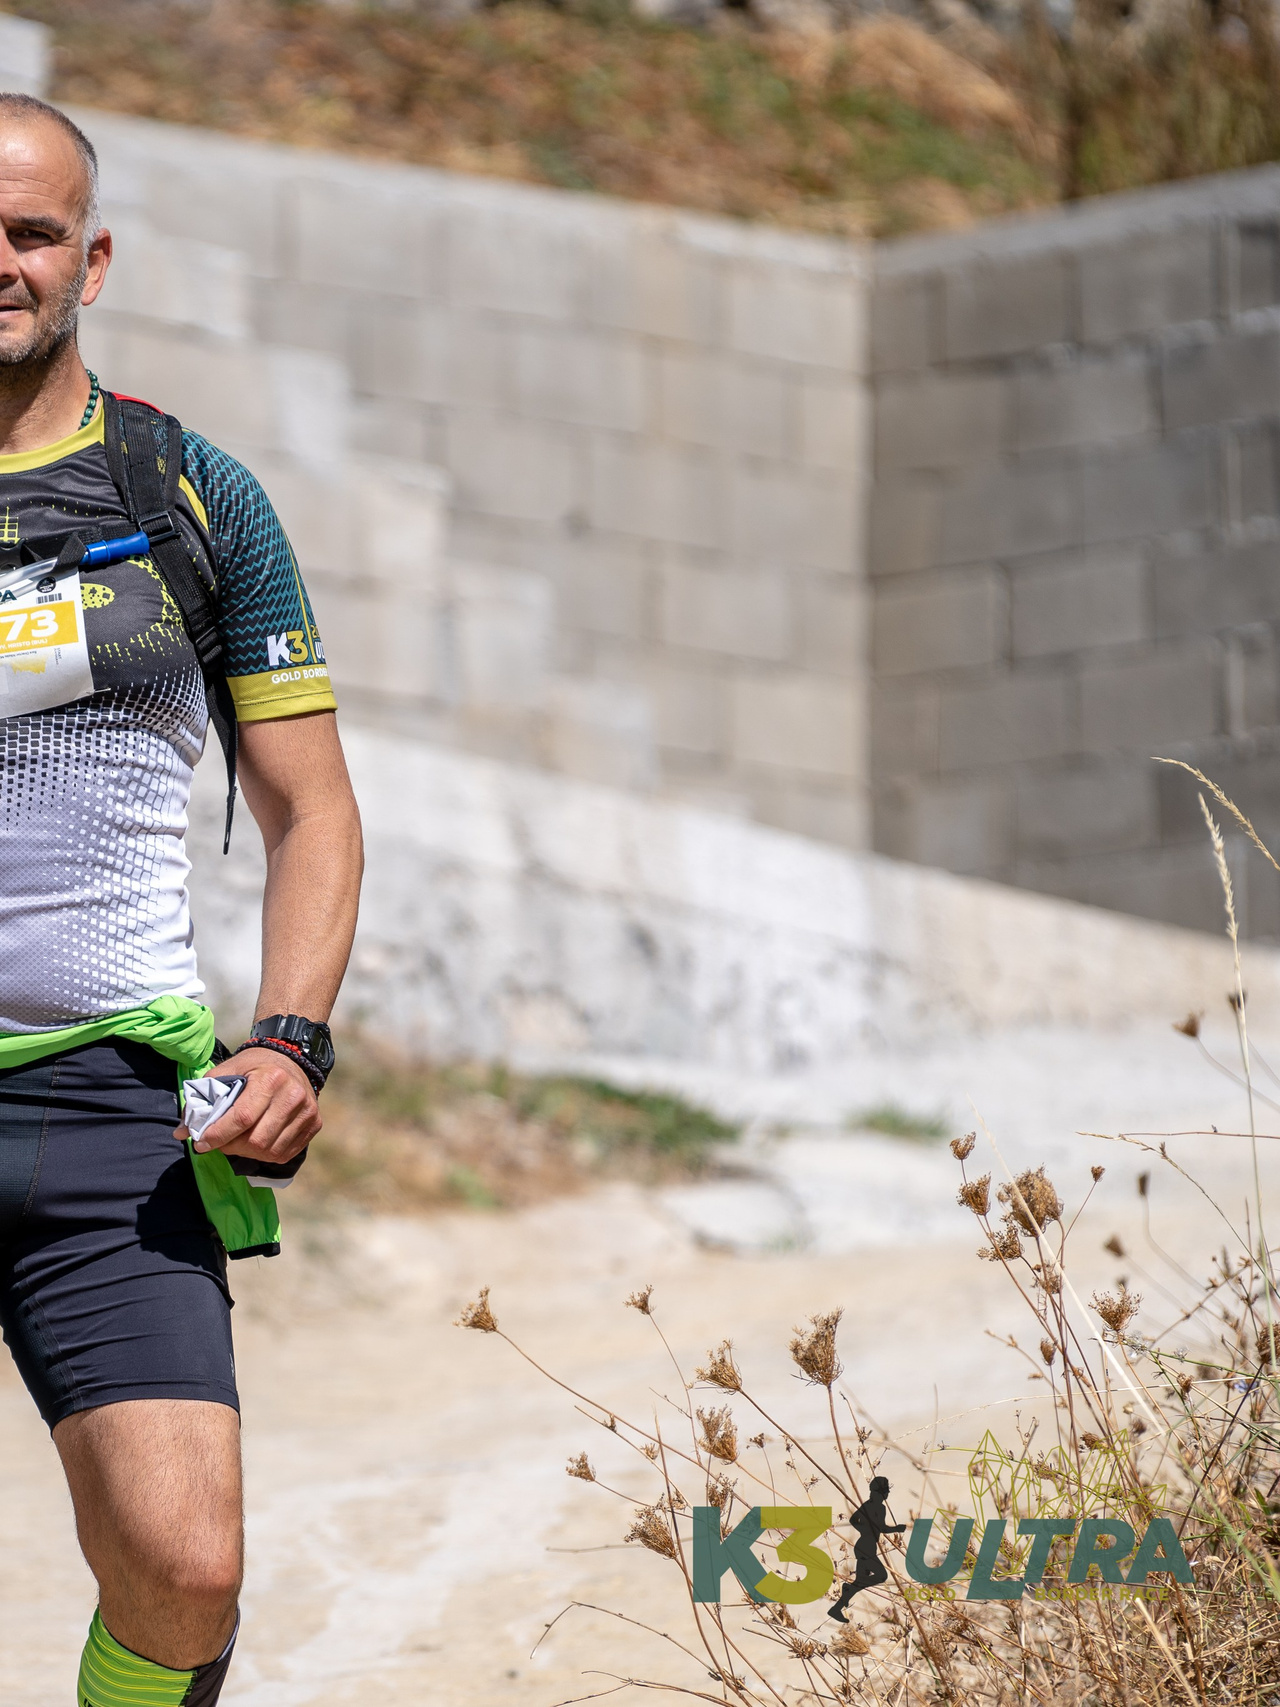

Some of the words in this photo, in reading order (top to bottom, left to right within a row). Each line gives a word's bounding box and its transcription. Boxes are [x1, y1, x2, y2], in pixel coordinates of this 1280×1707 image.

[7, 641, 31, 649] HRISTO
[31, 638, 48, 646] (BUL)
[266, 630, 309, 667] K3
[271, 670, 301, 684] GOLD
